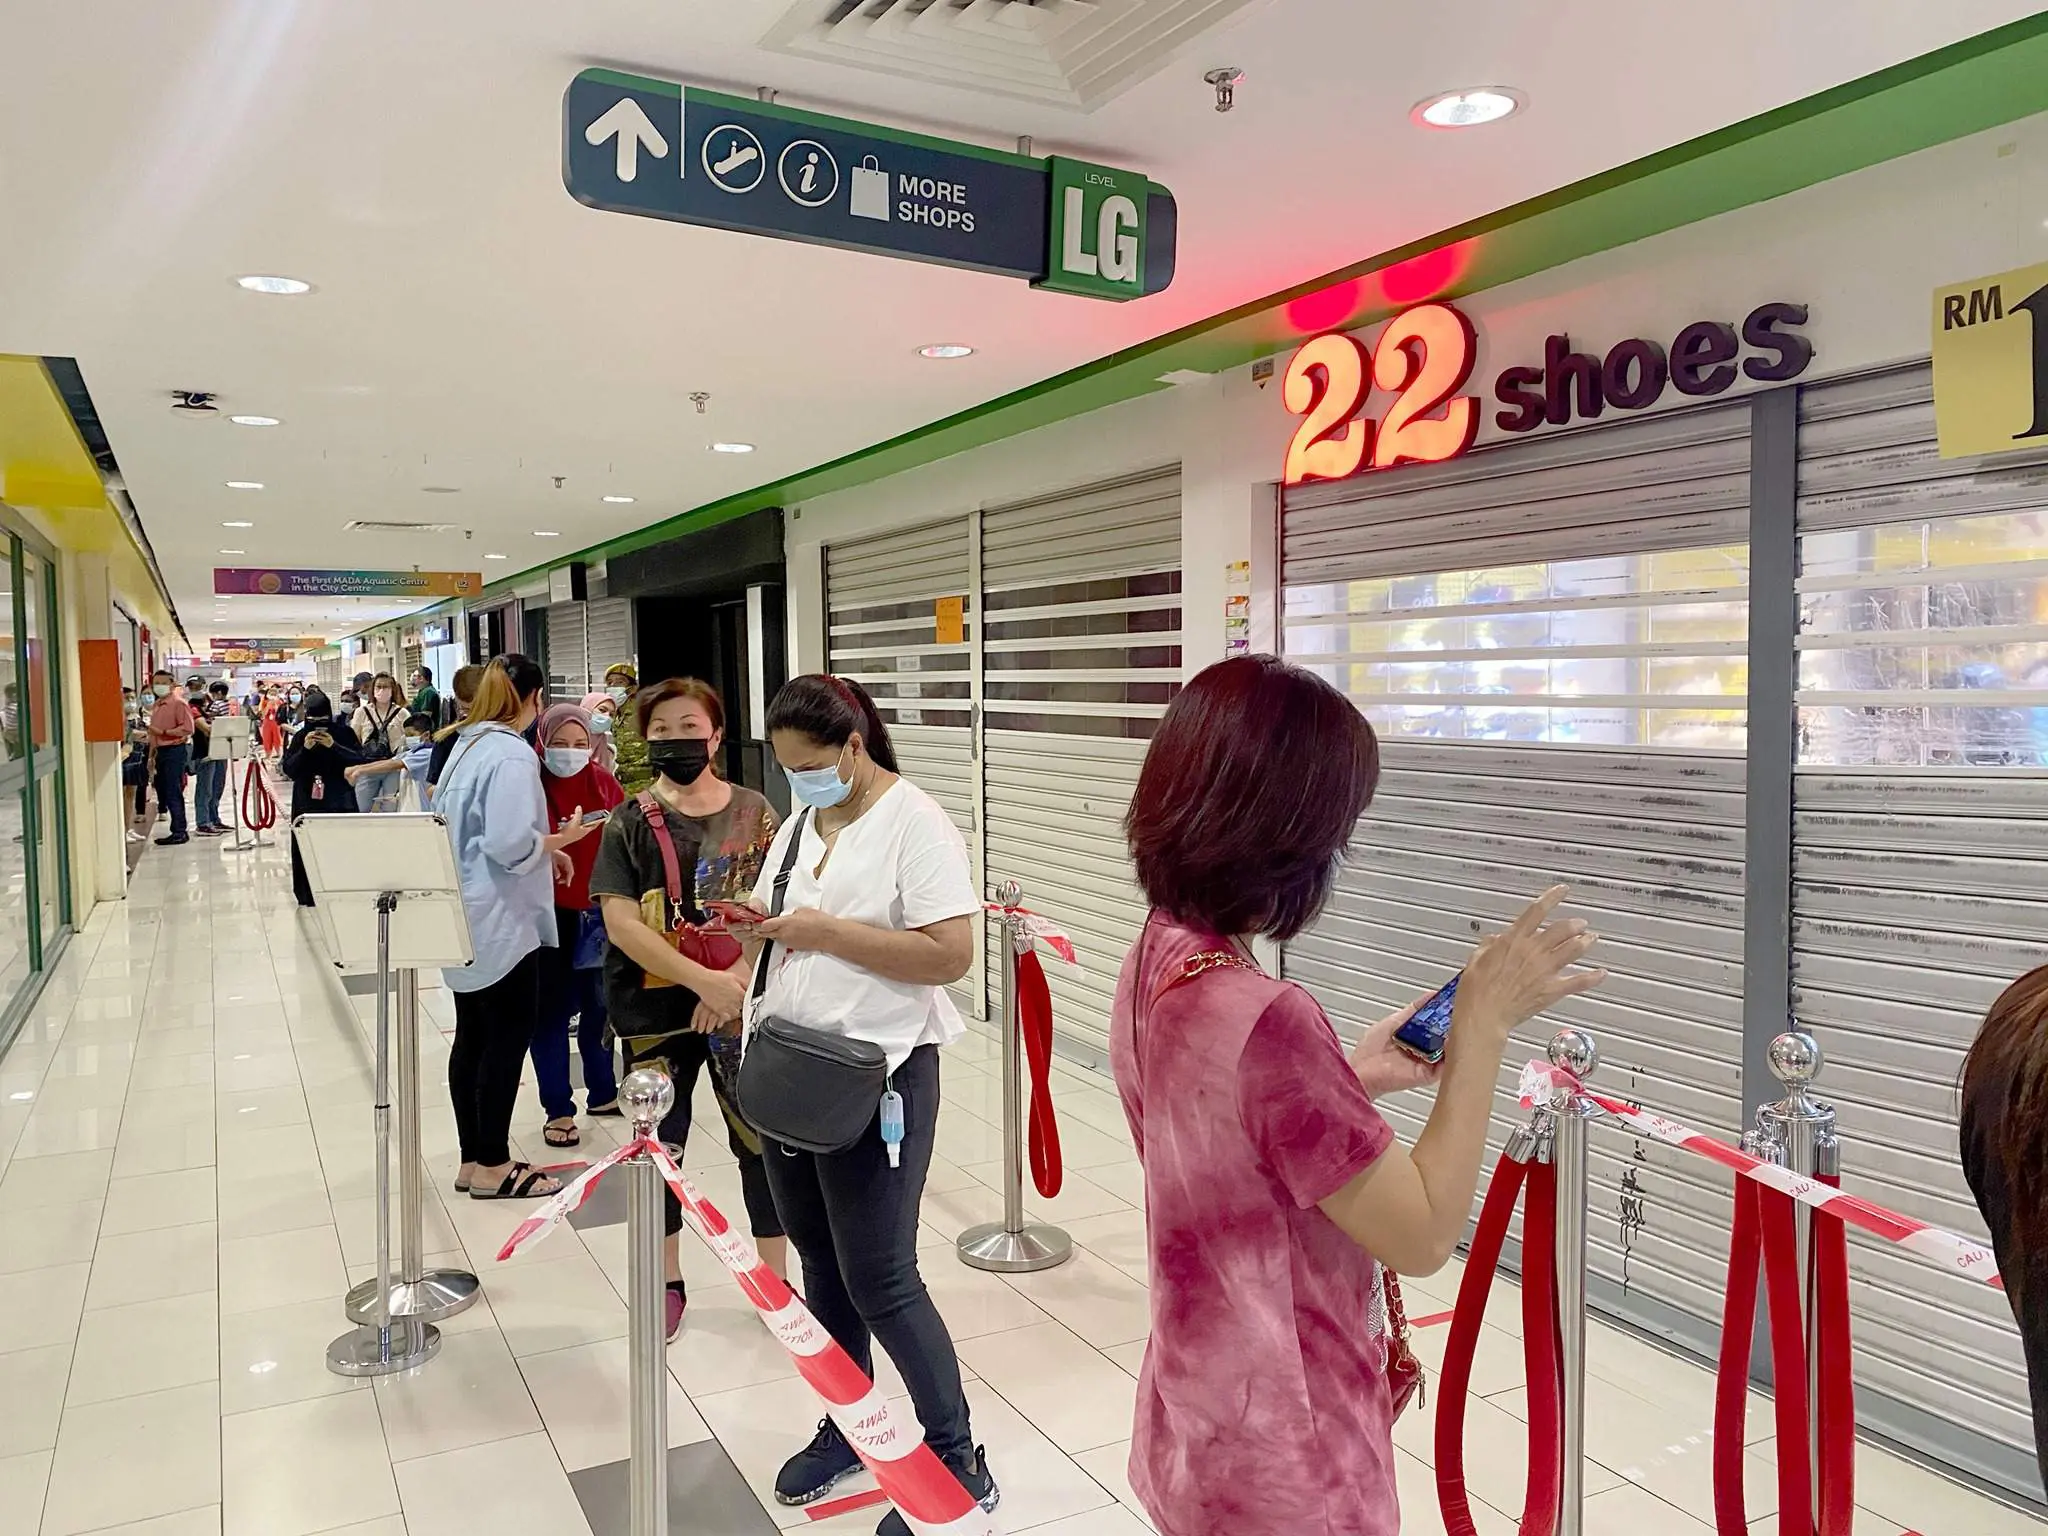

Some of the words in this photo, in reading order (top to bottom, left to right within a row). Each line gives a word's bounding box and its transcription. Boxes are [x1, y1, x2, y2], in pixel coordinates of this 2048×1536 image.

[899, 174, 967, 206] MORE
[1085, 172, 1117, 188] LEVEL
[898, 201, 976, 233] SHOPS
[1062, 186, 1139, 283] LG
[1944, 284, 2003, 331] RM
[1284, 302, 1481, 485] 22
[1494, 302, 1813, 433] shoes
[291, 576, 306, 584] The
[311, 576, 331, 584] First
[363, 577, 397, 586] Aquatic
[399, 577, 429, 586] Centre
[303, 583, 318, 592] the
[320, 584, 339, 593] City
[341, 584, 372, 592] Centre
[854, 1405, 888, 1429] AWAS
